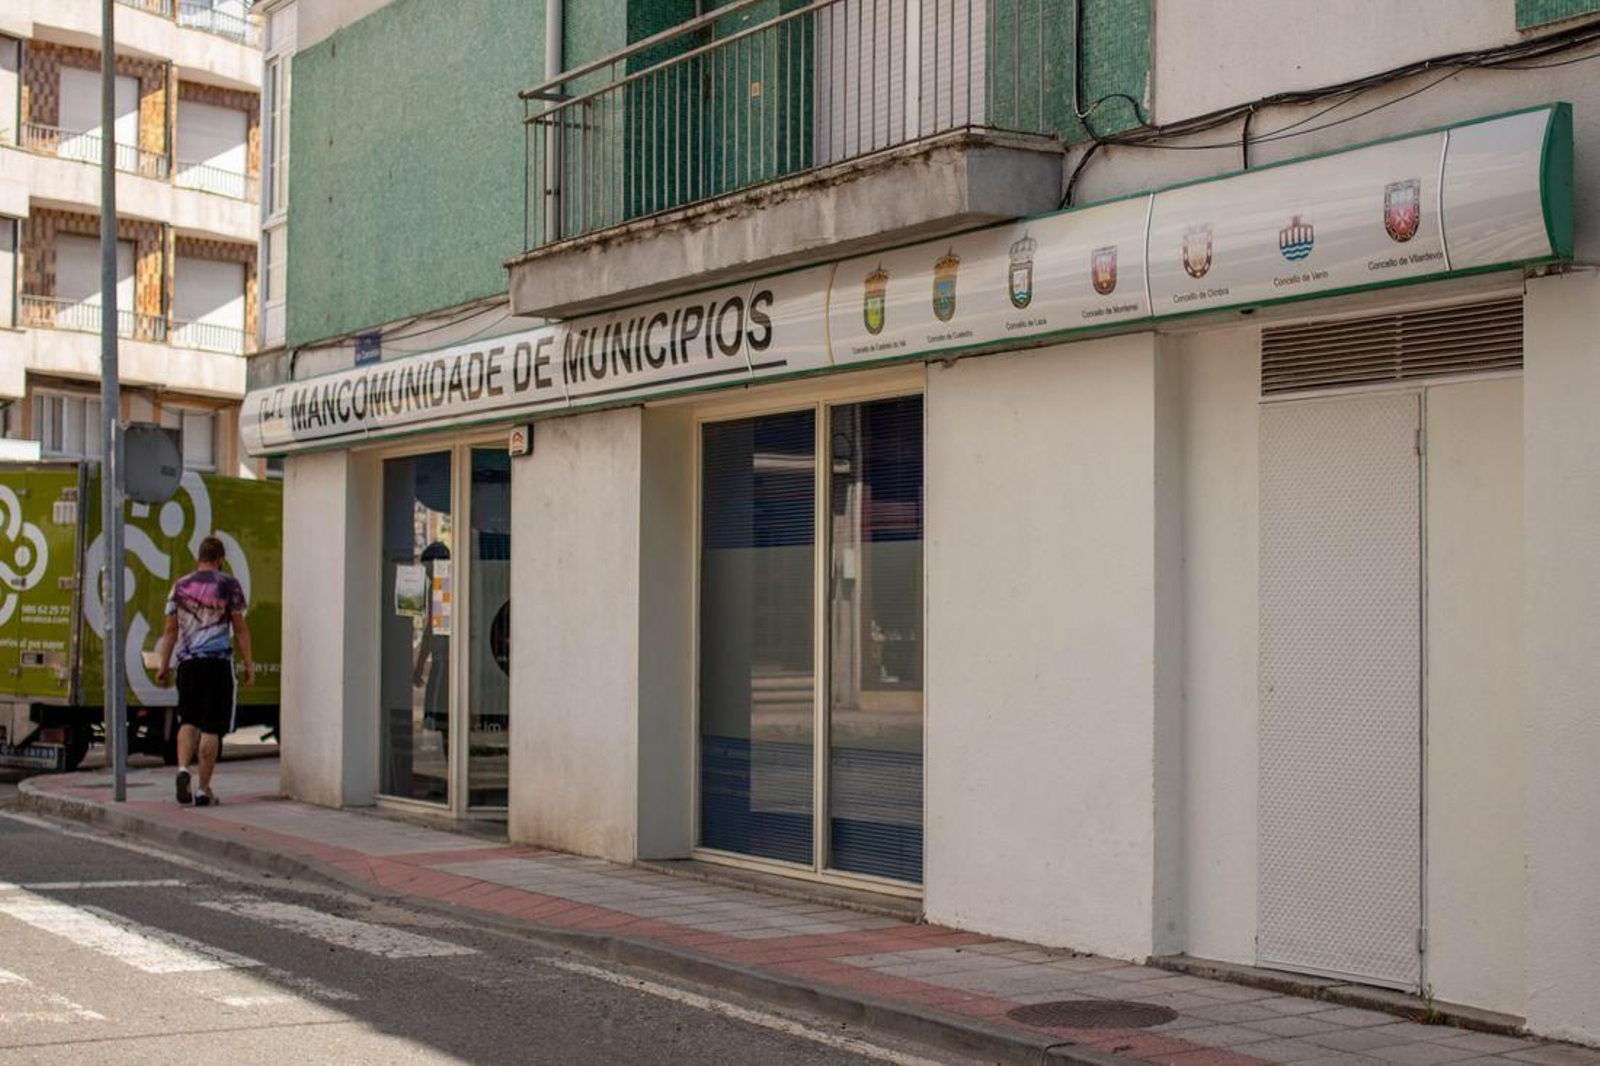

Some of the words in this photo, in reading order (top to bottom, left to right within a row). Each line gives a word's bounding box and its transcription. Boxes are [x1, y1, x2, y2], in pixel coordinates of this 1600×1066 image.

[1368, 257, 1398, 270] Concello
[1399, 256, 1408, 266] de
[1273, 275, 1300, 288] Concello
[1301, 273, 1311, 282] de
[1173, 293, 1199, 304] Concello
[1199, 290, 1206, 299] de
[1081, 308, 1105, 319] Concello
[1005, 320, 1027, 331] Concello
[290, 346, 504, 431] MANCOMUNIDADE
[513, 335, 554, 393] DE
[563, 290, 773, 385] MUNICIPIOS
